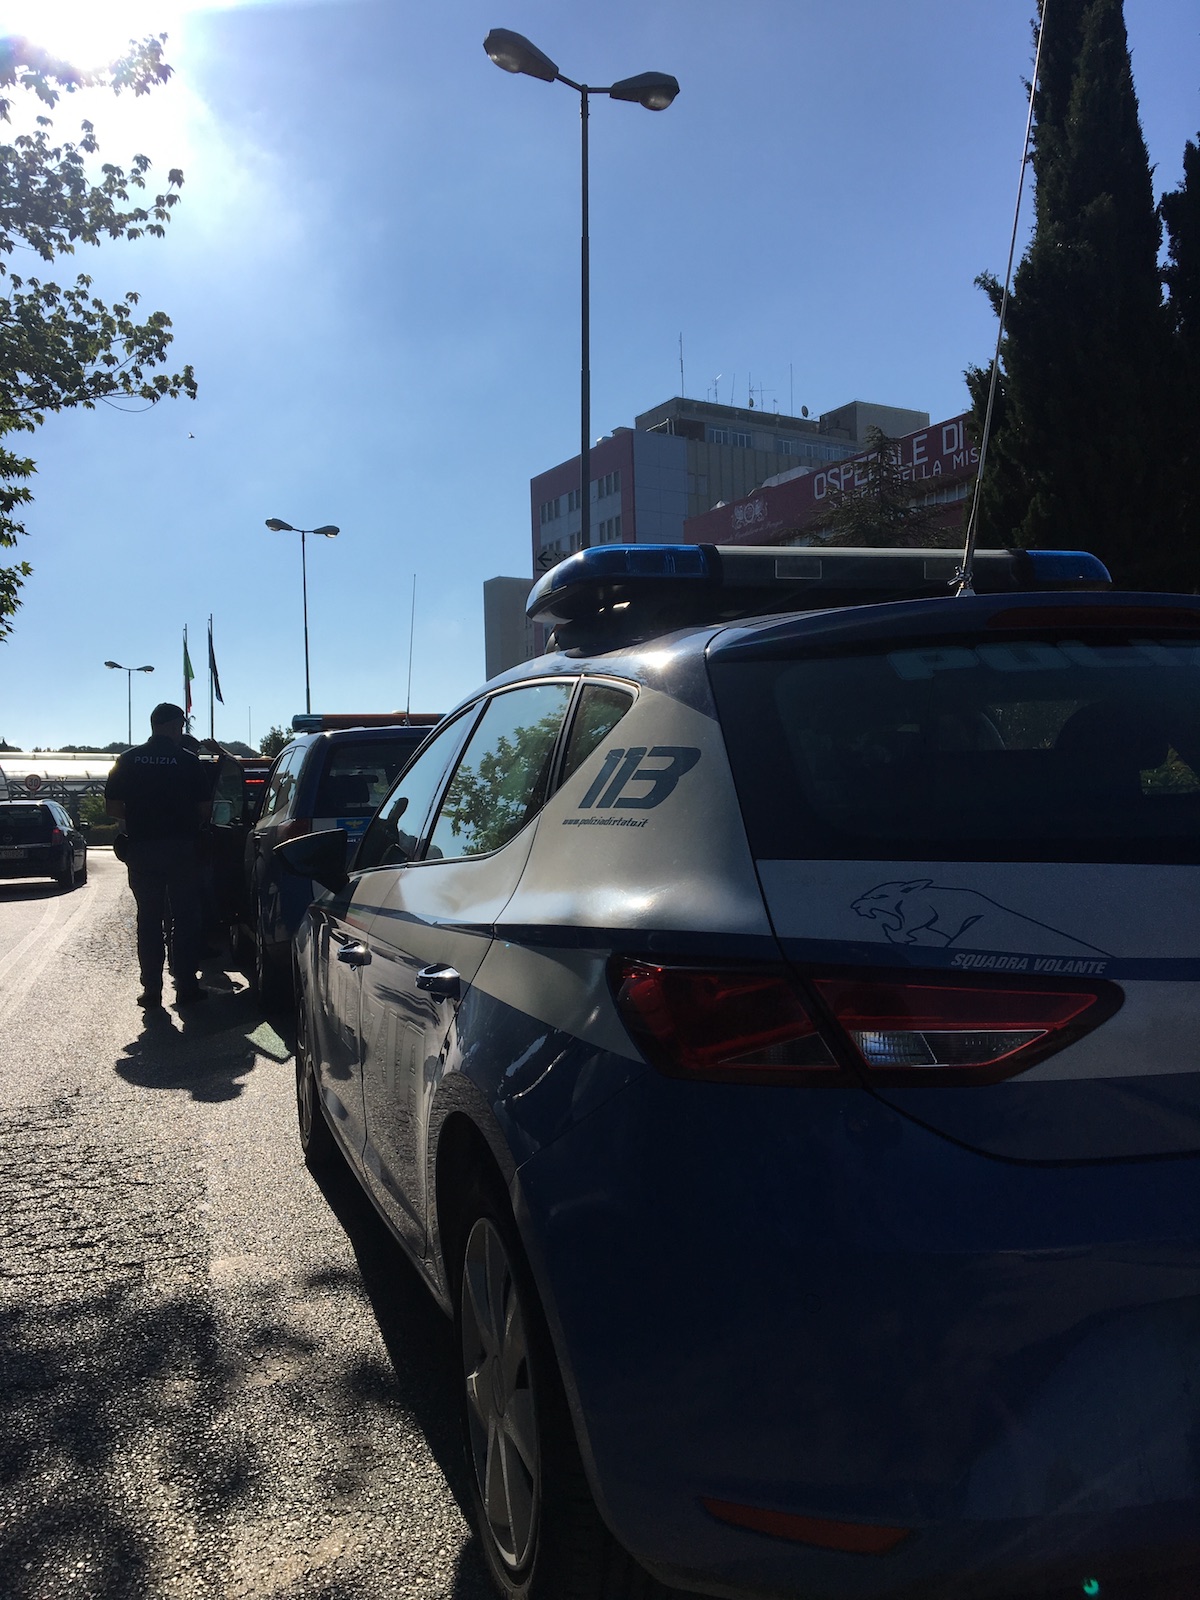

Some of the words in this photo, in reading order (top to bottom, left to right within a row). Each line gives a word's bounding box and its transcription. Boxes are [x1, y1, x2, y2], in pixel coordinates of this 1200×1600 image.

[814, 434, 929, 500] OSPELE
[942, 420, 964, 456] DI
[134, 755, 178, 765] POLIZIA
[29, 778, 39, 787] 30
[578, 746, 702, 810] 113
[562, 816, 649, 828] www.poliziadistato.it
[951, 952, 1027, 970] SQUADRA
[1033, 958, 1108, 975] VOLANTE
